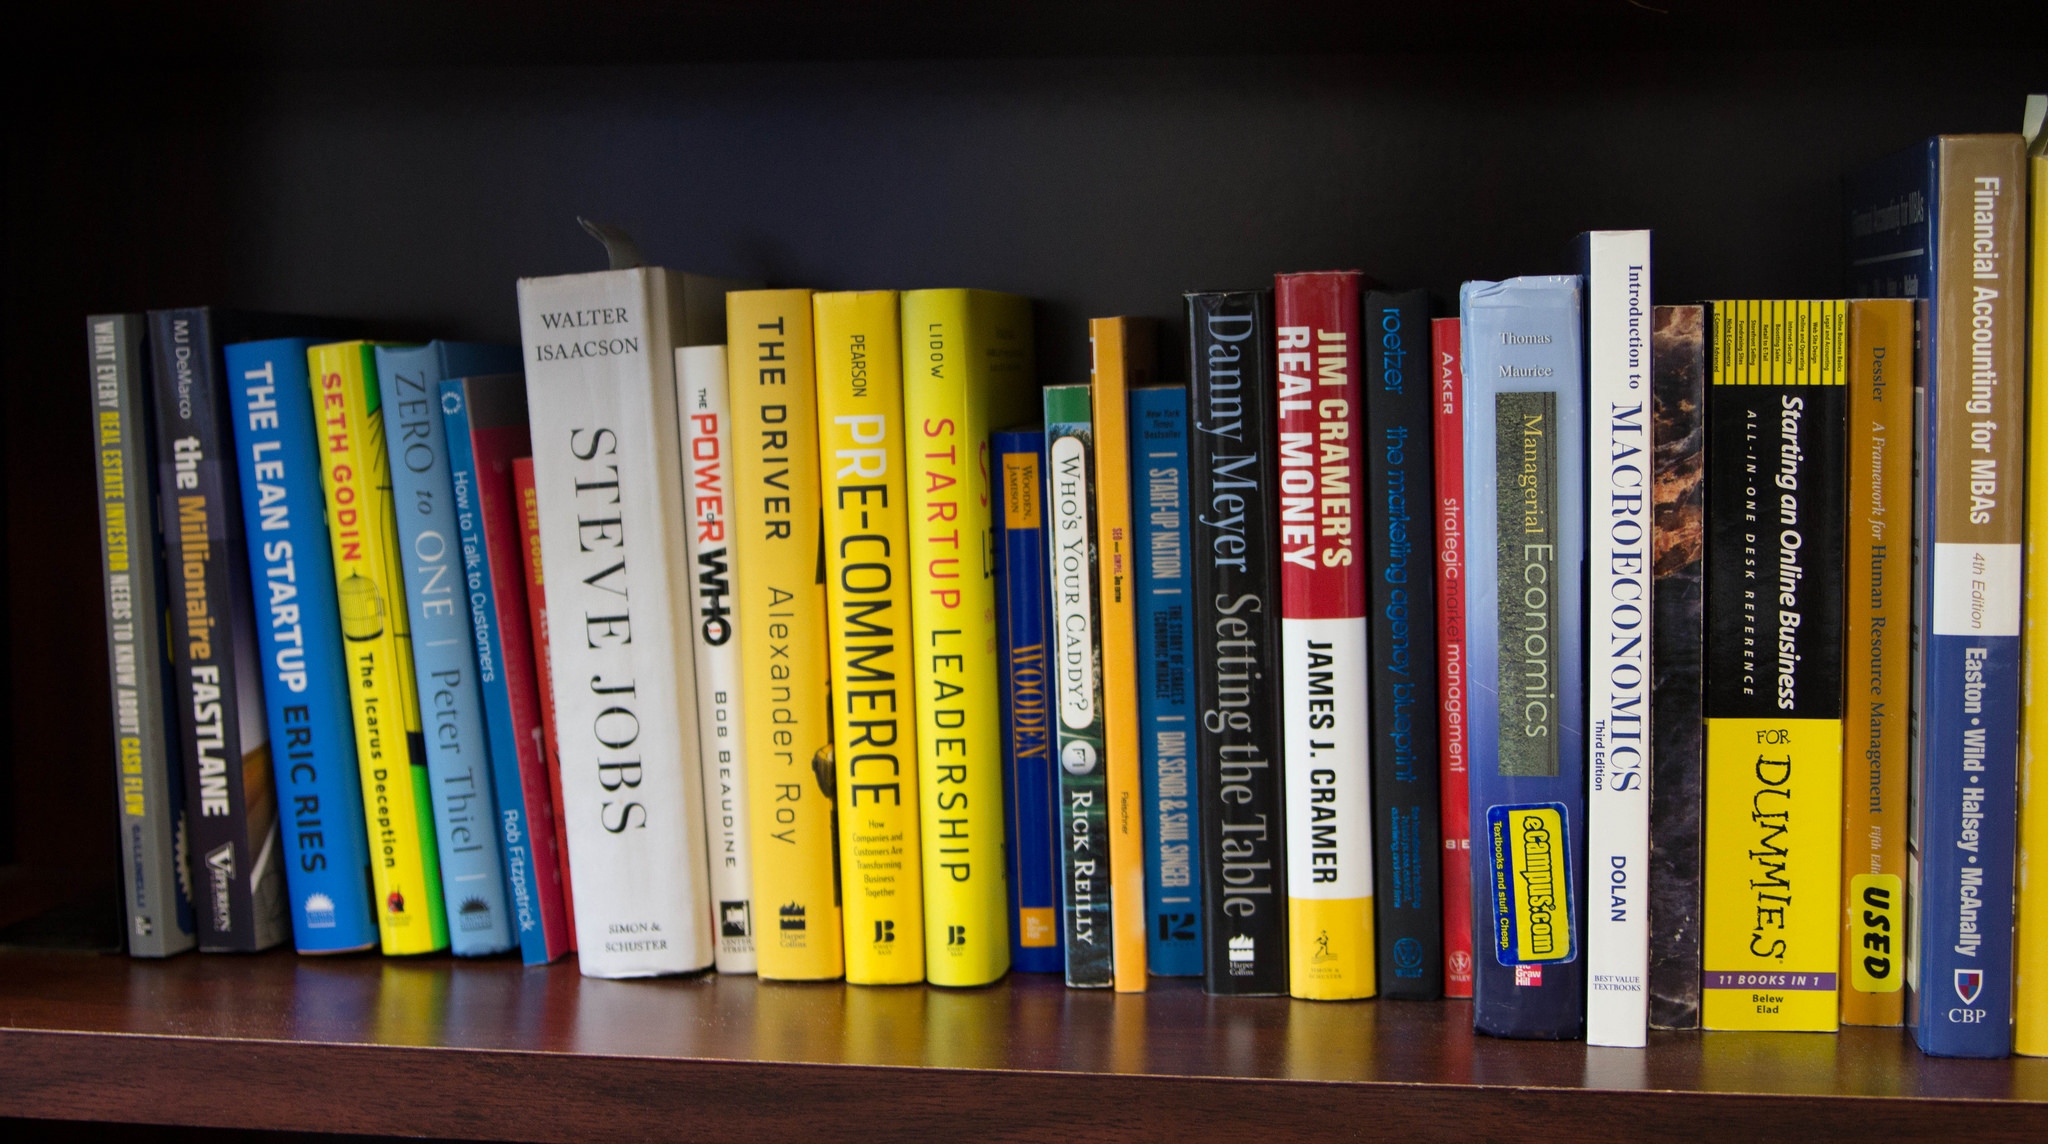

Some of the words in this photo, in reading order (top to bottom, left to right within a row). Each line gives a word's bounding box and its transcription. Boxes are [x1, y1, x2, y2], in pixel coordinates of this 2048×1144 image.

[1973, 176, 1999, 279] Financial
[93, 322, 114, 359] WHAT
[173, 320, 188, 344] MJ
[541, 307, 630, 331] WALTER
[1499, 331, 1552, 345] Thomas
[1628, 264, 1644, 368] Introduction
[536, 337, 640, 362] ISAACSON
[758, 316, 787, 386] THE
[850, 334, 867, 398] PEARSON
[928, 323, 945, 379] LIDOW
[1196, 311, 1253, 443] Danny
[1277, 326, 1313, 418] REAL
[1317, 330, 1348, 385] JIM
[1383, 308, 1406, 394] roetzer
[1499, 364, 1553, 378] Maurice
[1629, 372, 1639, 389] to
[1872, 346, 1886, 402] Dessler
[1966, 286, 1999, 414] Accounting
[96, 364, 119, 408] EVERY
[174, 347, 191, 420] DeMarco
[244, 362, 279, 430] THE
[322, 373, 349, 452] SETH
[698, 388, 707, 409] THE
[1441, 353, 1454, 415] AAKER
[99, 411, 121, 447] REAL
[396, 371, 435, 474] ZERO
[1386, 426, 1408, 465] the
[1775, 394, 1804, 490] Starting
[1872, 422, 1884, 434] A
[1971, 421, 1998, 452] for
[101, 450, 124, 499] ESTATE
[173, 437, 204, 489] the
[252, 441, 289, 531] LEAN
[454, 471, 469, 505] How
[691, 413, 726, 544] POWER
[761, 404, 792, 541] DRIVER
[1007, 464, 1020, 514] JAMISON
[1061, 454, 1084, 532] WHO'S
[1318, 399, 1352, 568] CRAMER'S
[1517, 413, 1544, 535] Managerial
[1745, 409, 1757, 523] ALL-IN-ONE
[1871, 438, 1885, 515] Framework
[1969, 454, 1998, 525] MBAs
[332, 464, 362, 562] GODIN
[416, 490, 434, 515] to
[461, 507, 472, 531] to
[924, 417, 962, 610] STARTUP
[1149, 468, 1180, 529] START-UP
[1199, 452, 1258, 574] Meyer
[1280, 432, 1316, 571] MONEY
[1384, 470, 1412, 583] marketing
[1780, 493, 1798, 526] an
[1868, 519, 1882, 540] for
[104, 501, 129, 571] INVESTOR
[463, 534, 478, 571] Talk
[570, 426, 633, 650] STEVE
[1062, 534, 1087, 603] YOUR
[1151, 531, 1182, 579] NATION
[1744, 533, 1755, 579] DESK
[1779, 530, 1803, 608] Online
[1972, 552, 1986, 574] 4th
[110, 574, 132, 617] NEEDS
[178, 496, 211, 659] Millionaire
[415, 531, 455, 620] ONE
[468, 572, 481, 590] to
[698, 547, 732, 647] WHO
[1610, 401, 1644, 792] MACROECONOMICS
[1871, 545, 1887, 610] Human
[1971, 579, 1986, 630] Edition
[112, 622, 133, 641] TO
[264, 541, 308, 693] STARTUP
[472, 592, 495, 683] Customers
[834, 413, 900, 809] PRE-COMMERCE
[1385, 588, 1410, 676] agency
[1524, 542, 1556, 738] Economics
[1743, 591, 1755, 696] REFERENCE
[113, 644, 136, 687] KNOW
[359, 653, 374, 691] The
[767, 586, 801, 767] Alexander
[1065, 606, 1090, 712] CADDY?
[1204, 594, 1263, 734] Setting
[1307, 640, 1335, 730] JAMES
[1777, 611, 1802, 711] Business
[1871, 616, 1886, 696] Resource
[1965, 647, 1988, 714] Easton
[118, 690, 140, 734] ABOUT
[363, 693, 382, 760] Icarus
[432, 669, 462, 755] Peter
[715, 692, 728, 738] BOB
[1012, 644, 1047, 760] WOODEN
[1390, 683, 1417, 782] blueprint
[1595, 719, 1605, 749] Third
[121, 738, 142, 773] CASH
[190, 666, 230, 817] FASTLANE
[284, 705, 316, 783] ERIC
[590, 676, 648, 834] JOBS
[931, 628, 971, 883] LEADERSHIP
[1309, 739, 1335, 758] J.
[1756, 729, 1791, 745] FOR
[1865, 702, 1886, 815] Management
[1962, 727, 1986, 772] Wild
[124, 775, 145, 816] FLOW
[1217, 746, 1270, 804] the
[1595, 753, 1606, 791] Edition
[292, 800, 327, 872] RIES
[374, 768, 396, 868] Deception
[445, 767, 484, 854] Thiel
[504, 809, 522, 844] Rob
[718, 751, 737, 869] BEAUDINE
[770, 784, 802, 846] Roy
[852, 834, 889, 844] Companies
[890, 832, 903, 842] and
[868, 819, 885, 830] How
[1072, 790, 1094, 852] RICK
[1310, 769, 1338, 885] CRAMER
[1868, 825, 1882, 850] Fifth
[1961, 787, 1984, 853] Halsey
[853, 847, 890, 857] Customers
[891, 846, 903, 855] Are
[857, 860, 902, 870] Transforming
[1222, 813, 1273, 917] Table
[1493, 820, 1504, 869] Textbooks
[1748, 754, 1792, 960] DUMMIES
[506, 847, 537, 933] Fitzpatrick
[864, 874, 895, 884] Business
[865, 888, 895, 899] Together
[1074, 859, 1097, 945] REILLY
[1497, 873, 1507, 889] and
[1499, 892, 1509, 915] stuff.
[1520, 816, 1556, 954] ecampus.com
[1611, 856, 1627, 923] DOLAN
[1500, 918, 1509, 950] Cheap.
[1863, 886, 1891, 980] USED
[1955, 868, 1984, 958] McAnally
[1593, 975, 1616, 984] BEST
[1617, 975, 1640, 984] VALUE
[1593, 983, 1641, 992] TEXTBOOKS
[1719, 975, 1734, 985] 11
[1738, 975, 1786, 986] BOOKS
[1790, 975, 1807, 986] IN
[1813, 976, 1819, 986] 1
[1752, 994, 1784, 1004] Belew
[1756, 1005, 1779, 1014] Elad
[1949, 1008, 1986, 1024] CBP
